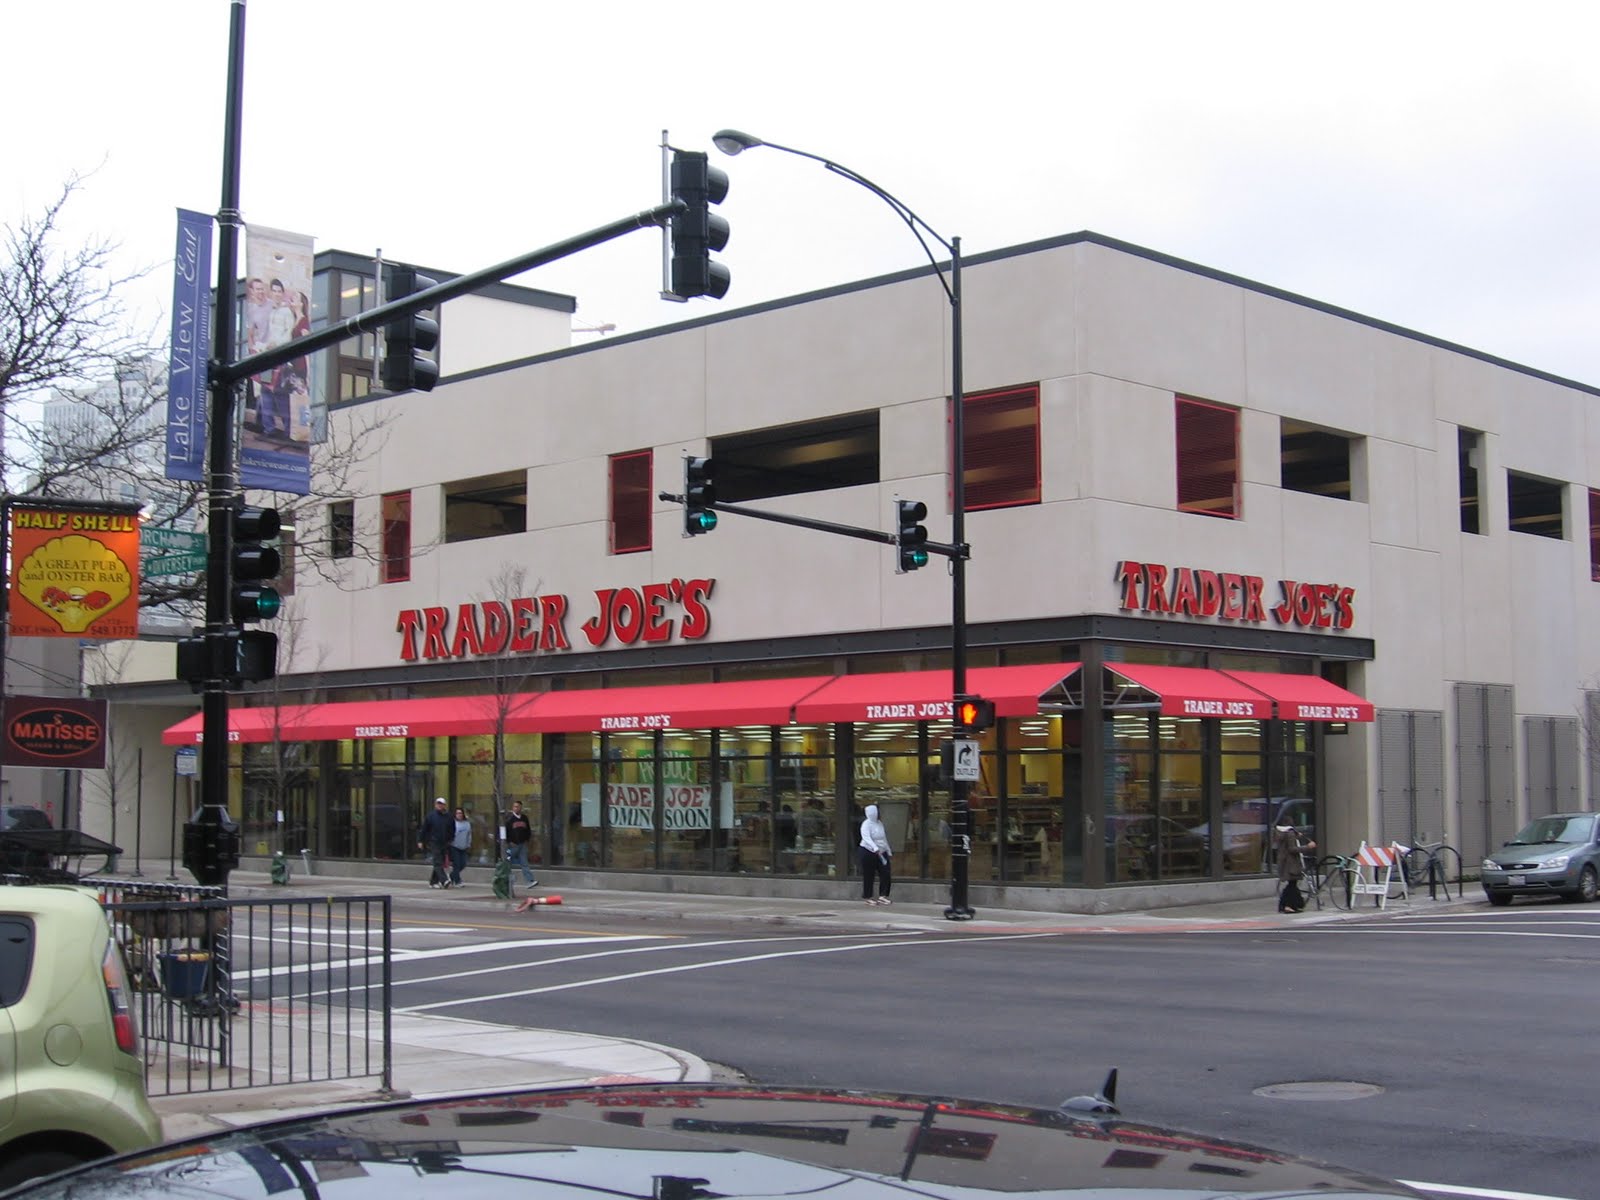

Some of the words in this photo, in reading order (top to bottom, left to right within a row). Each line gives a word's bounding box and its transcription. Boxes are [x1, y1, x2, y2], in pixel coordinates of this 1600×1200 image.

[177, 227, 198, 288] East
[173, 302, 194, 376] View
[170, 396, 190, 462] Lake
[16, 512, 69, 529] HALF
[72, 515, 134, 532] SHELL
[34, 560, 42, 569] A
[45, 560, 88, 570] GREAT
[92, 561, 117, 571] PUB
[26, 571, 44, 581] and
[47, 571, 96, 582] OYSTER
[99, 573, 124, 583] BAR
[1113, 560, 1267, 622] TRADER
[1269, 579, 1356, 630] JOE'S
[396, 593, 570, 662] TRADER
[580, 577, 716, 647] JOE'S
[866, 704, 915, 718] TRADER
[918, 702, 954, 716] JOE'S
[1183, 700, 1223, 714] TRADER
[1225, 701, 1254, 715] JOE'S
[1298, 705, 1332, 718] TRADER
[1333, 706, 1359, 719] JOE'S
[355, 726, 383, 737] TRADER
[385, 724, 409, 737] JOE'S
[601, 716, 639, 729] TRADER
[641, 714, 672, 728] JOE'S
[638, 750, 693, 783] PRDUCE
[607, 786, 652, 808] RADE
[666, 786, 712, 808] JOE'
[609, 807, 652, 827] OMIN
[665, 807, 710, 828] SOON
